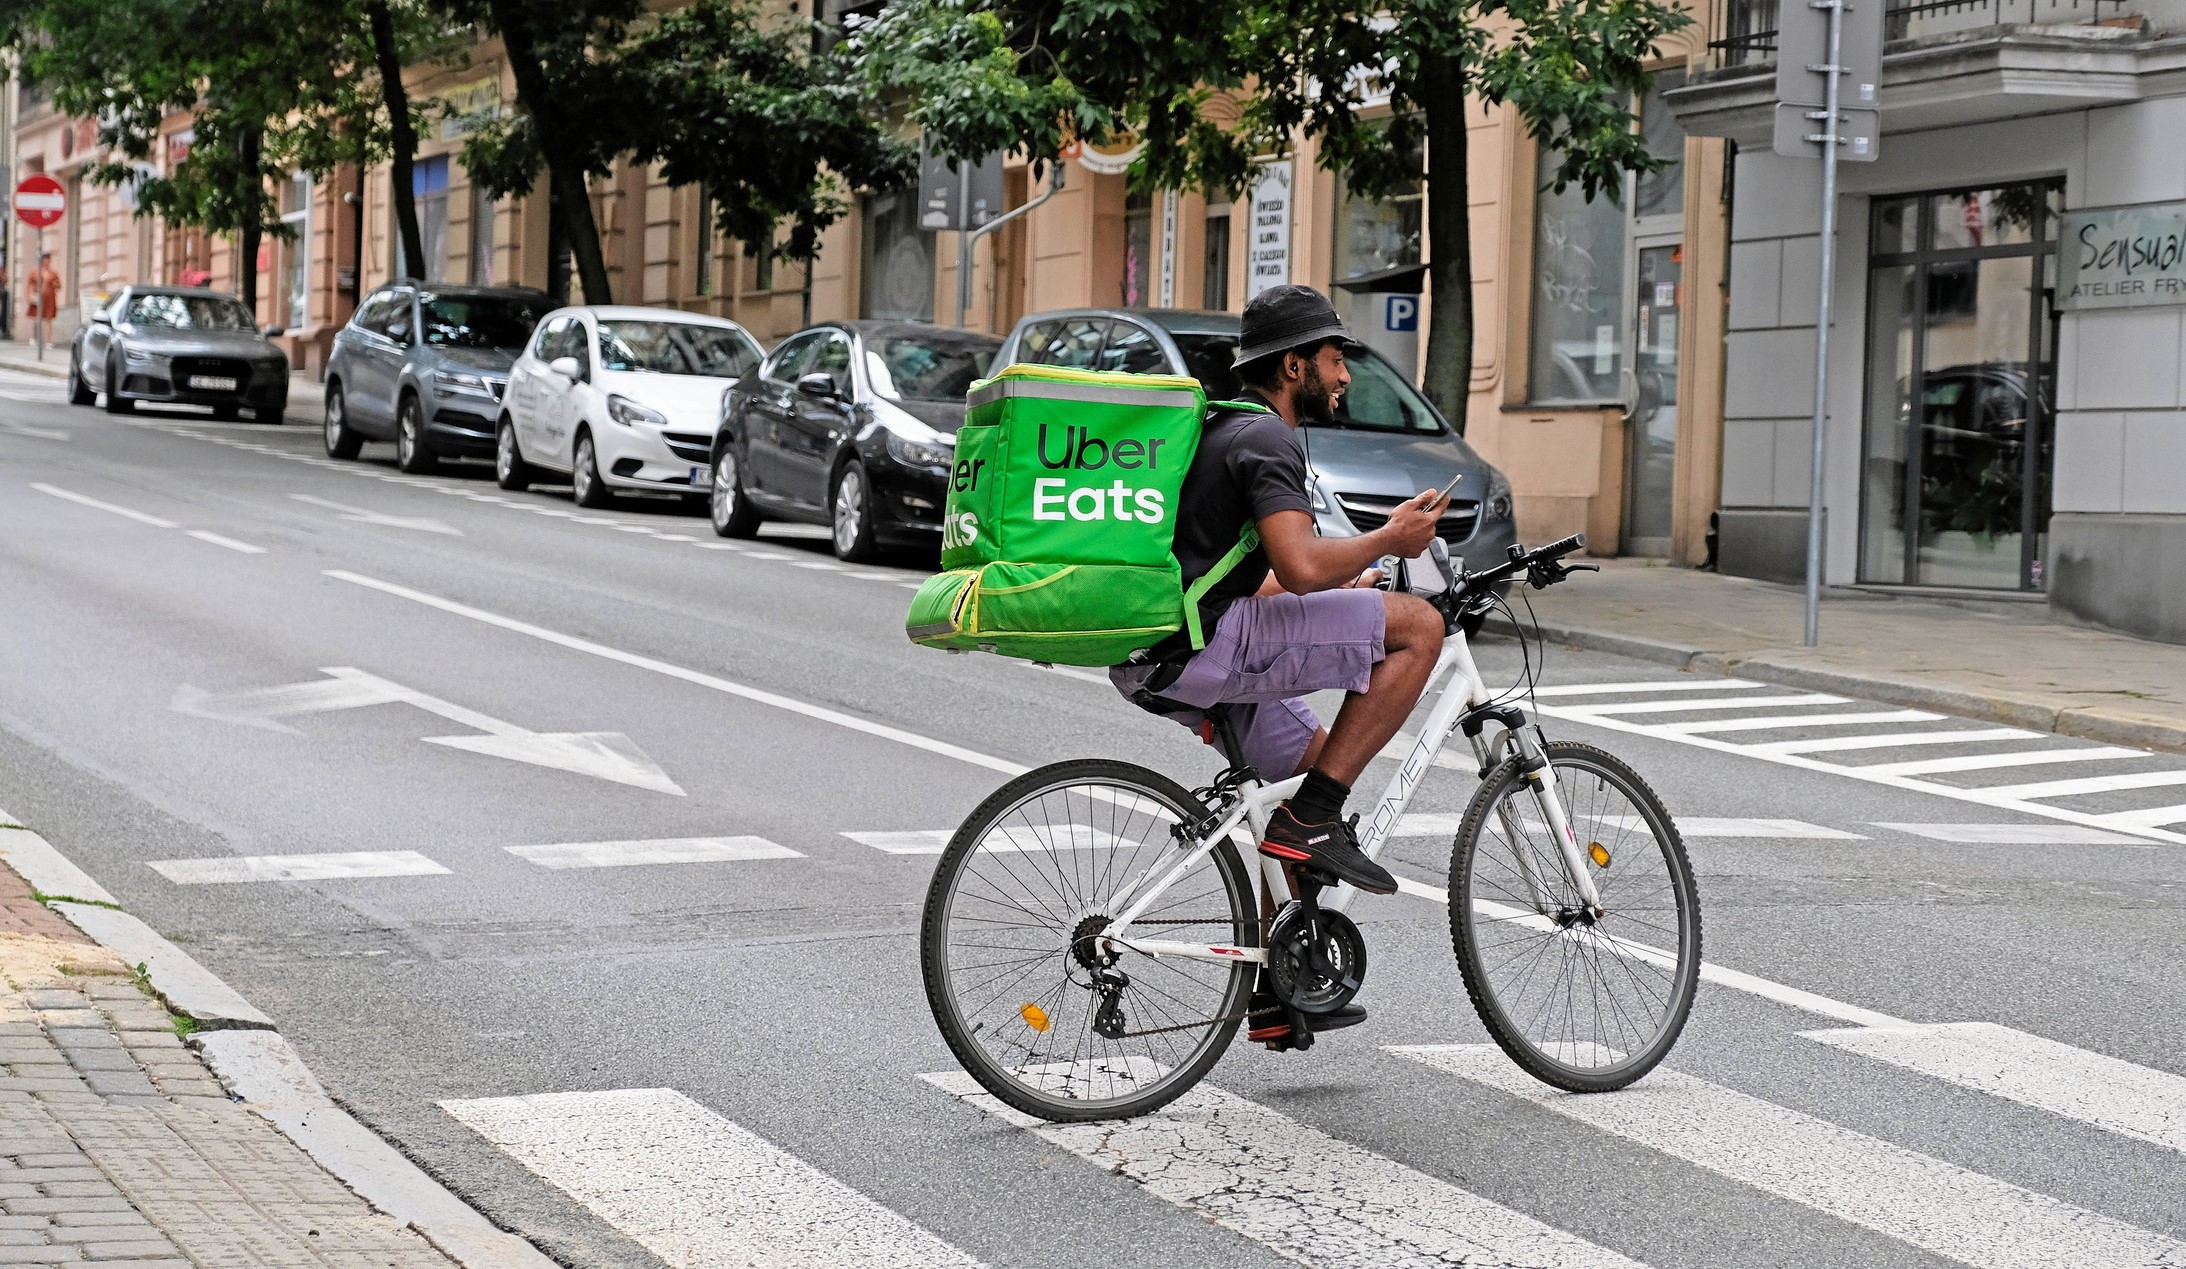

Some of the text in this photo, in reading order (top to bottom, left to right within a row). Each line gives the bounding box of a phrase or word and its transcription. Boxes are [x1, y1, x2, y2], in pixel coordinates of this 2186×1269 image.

[2079, 223, 2186, 276] Sensual
[2070, 280, 2145, 297] ATELIER
[1391, 299, 1414, 329] P
[1037, 423, 1166, 471] Uber
[948, 457, 985, 494] er
[1033, 477, 1165, 524] Eats
[1361, 729, 1430, 858] ROMET
